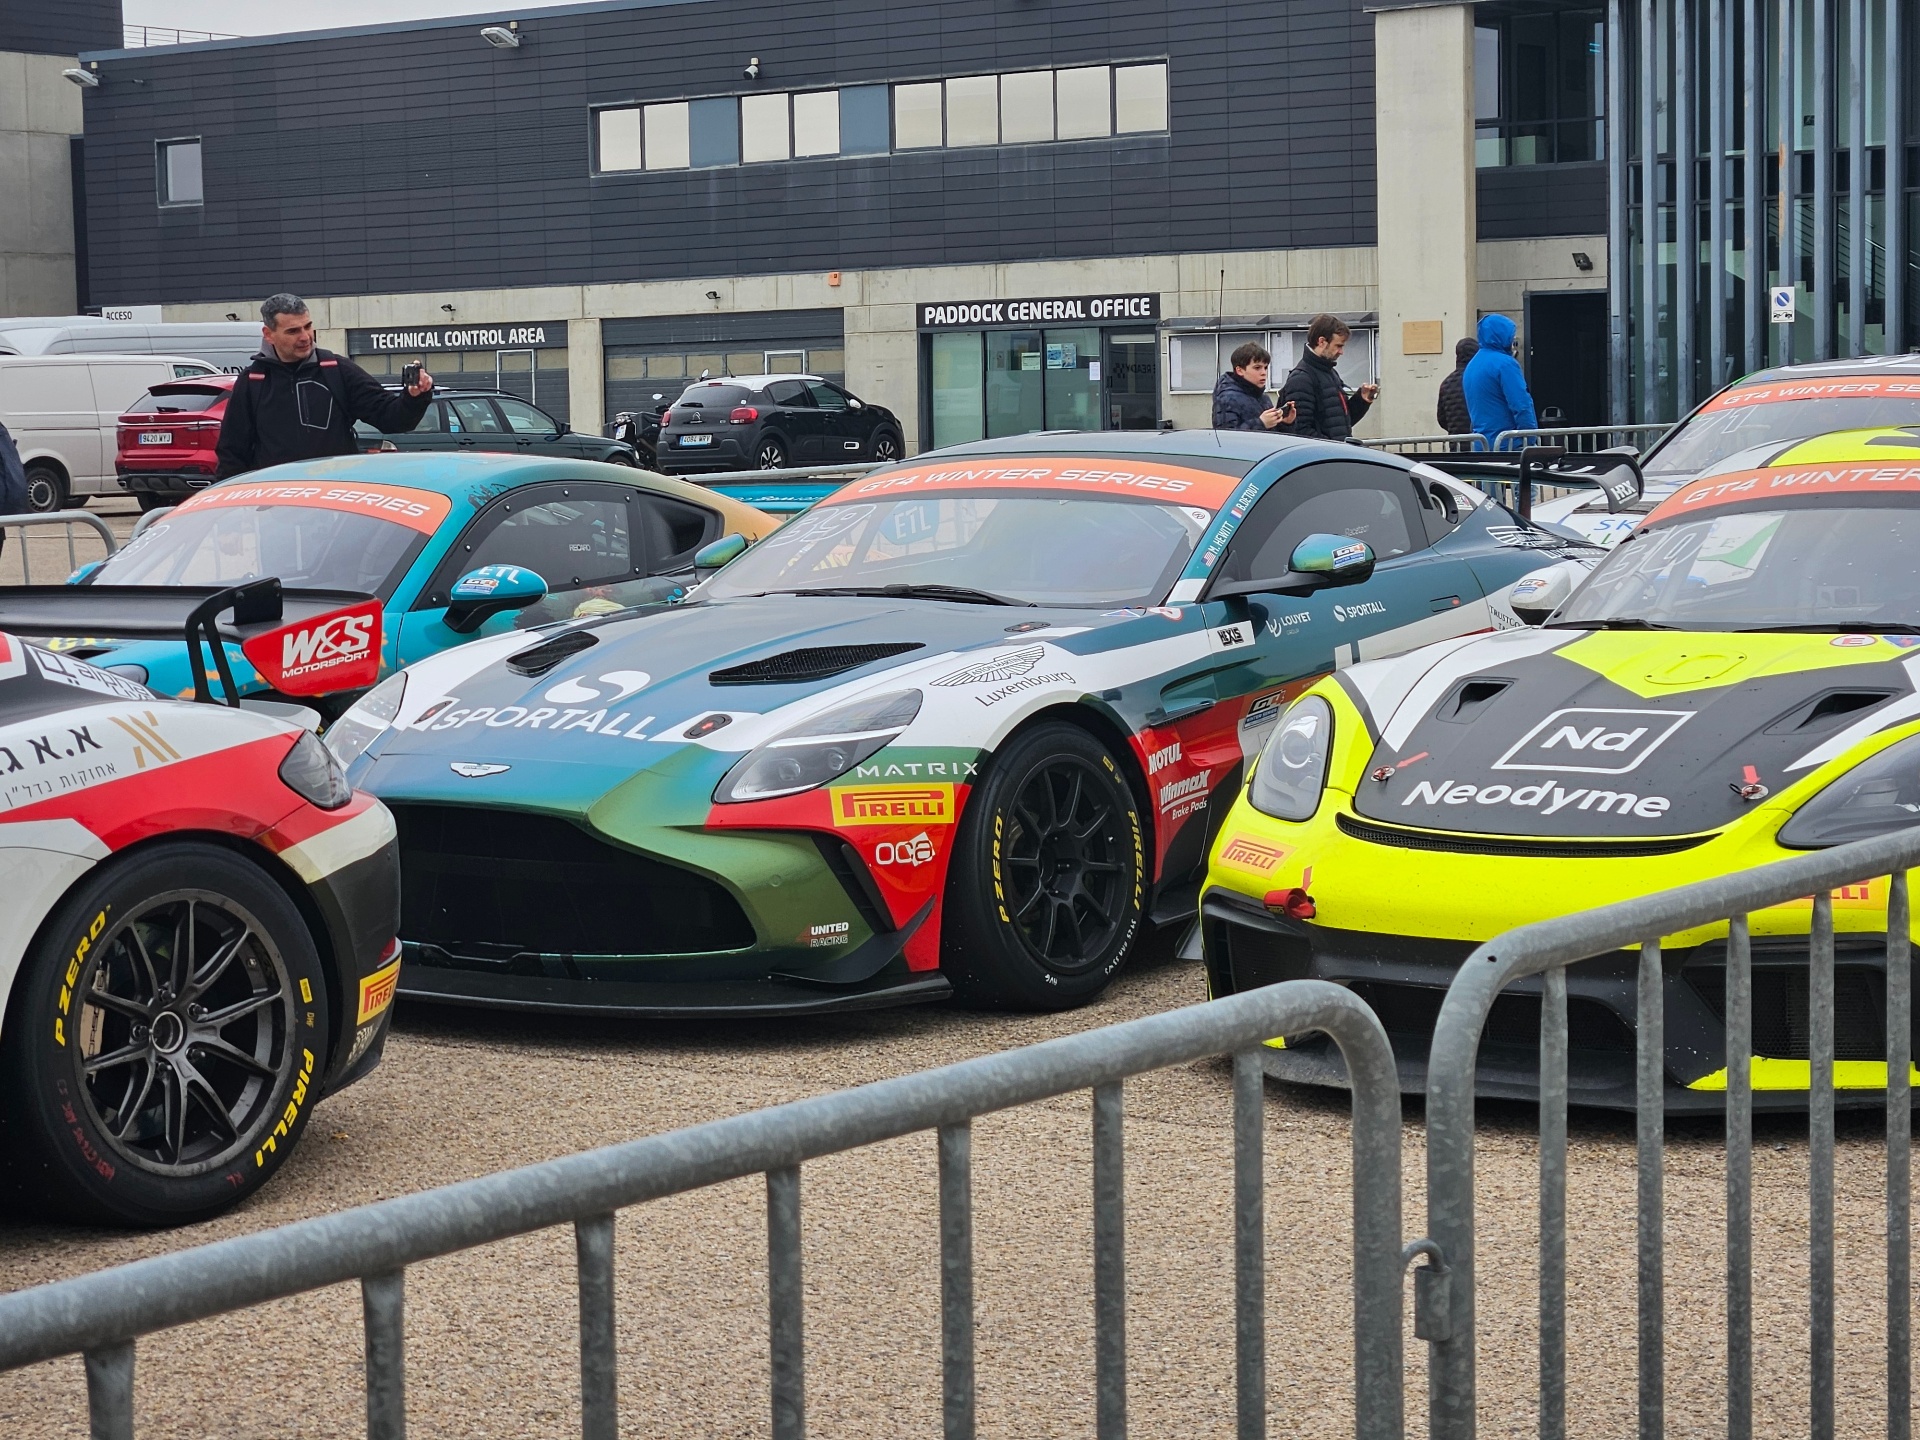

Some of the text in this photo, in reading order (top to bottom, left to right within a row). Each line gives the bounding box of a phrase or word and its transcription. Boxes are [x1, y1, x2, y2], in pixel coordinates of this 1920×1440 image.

[106, 311, 133, 321] ACCESO
[924, 297, 1151, 325] PADDOCK GENERAL OFFICE
[371, 327, 545, 349] TECHNICAL CONTROL AREA
[1722, 390, 1772, 405] GT4
[1779, 383, 1881, 396] WINTER
[858, 467, 1195, 493] GT4 WINTER SERIES
[1610, 480, 1637, 500] HRX
[1683, 477, 1760, 504] GT4
[216, 487, 323, 505] WINTER
[320, 487, 431, 517] SERIES
[895, 505, 931, 540] ETL
[1212, 520, 1235, 550] HEWITT
[478, 566, 519, 585] ETL
[1282, 611, 1312, 625] LOUYET
[1346, 601, 1387, 618] SPORTALL
[282, 614, 374, 669] W&S
[1217, 627, 1245, 647] HEXIS
[282, 650, 371, 679] MOTORSPORT
[971, 656, 1022, 677] ASTON MARTIN
[975, 671, 1077, 708] Luxembourg
[432, 705, 656, 740] SPORTALL
[1540, 725, 1649, 751] Nd
[856, 762, 979, 778] MATRIX
[1148, 742, 1183, 775] MOTUL
[841, 790, 945, 818] PIRELLI
[1172, 797, 1208, 820] Brake Pads
[1401, 780, 1671, 818] Neodyme
[1127, 810, 1143, 911] PIRELLI
[1222, 838, 1285, 870] PIRELLI
[810, 933, 848, 948] RACING
[811, 921, 849, 936] UNITED
[256, 1048, 315, 1168] PIRELLI
